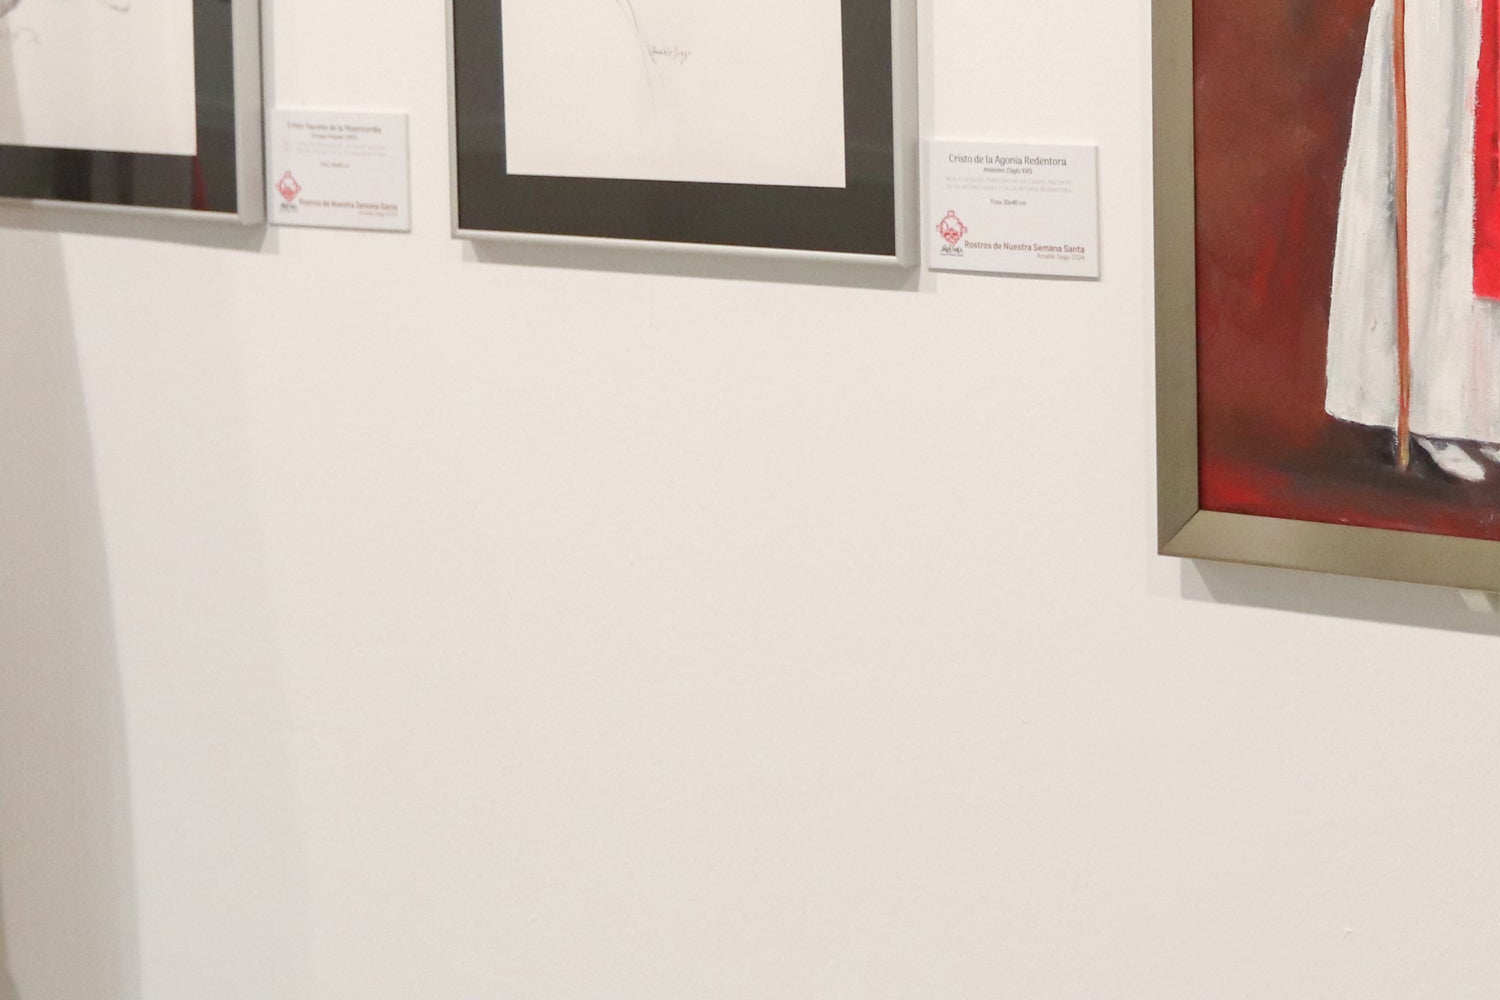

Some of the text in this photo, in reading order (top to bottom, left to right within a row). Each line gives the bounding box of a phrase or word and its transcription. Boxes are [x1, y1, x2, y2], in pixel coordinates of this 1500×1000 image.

[948, 154, 972, 163] Cristo
[974, 154, 984, 164] de
[985, 154, 993, 164] la
[1024, 155, 1067, 166] Redentora
[964, 240, 1085, 254] Rostros de Nuestra Semana Santa
